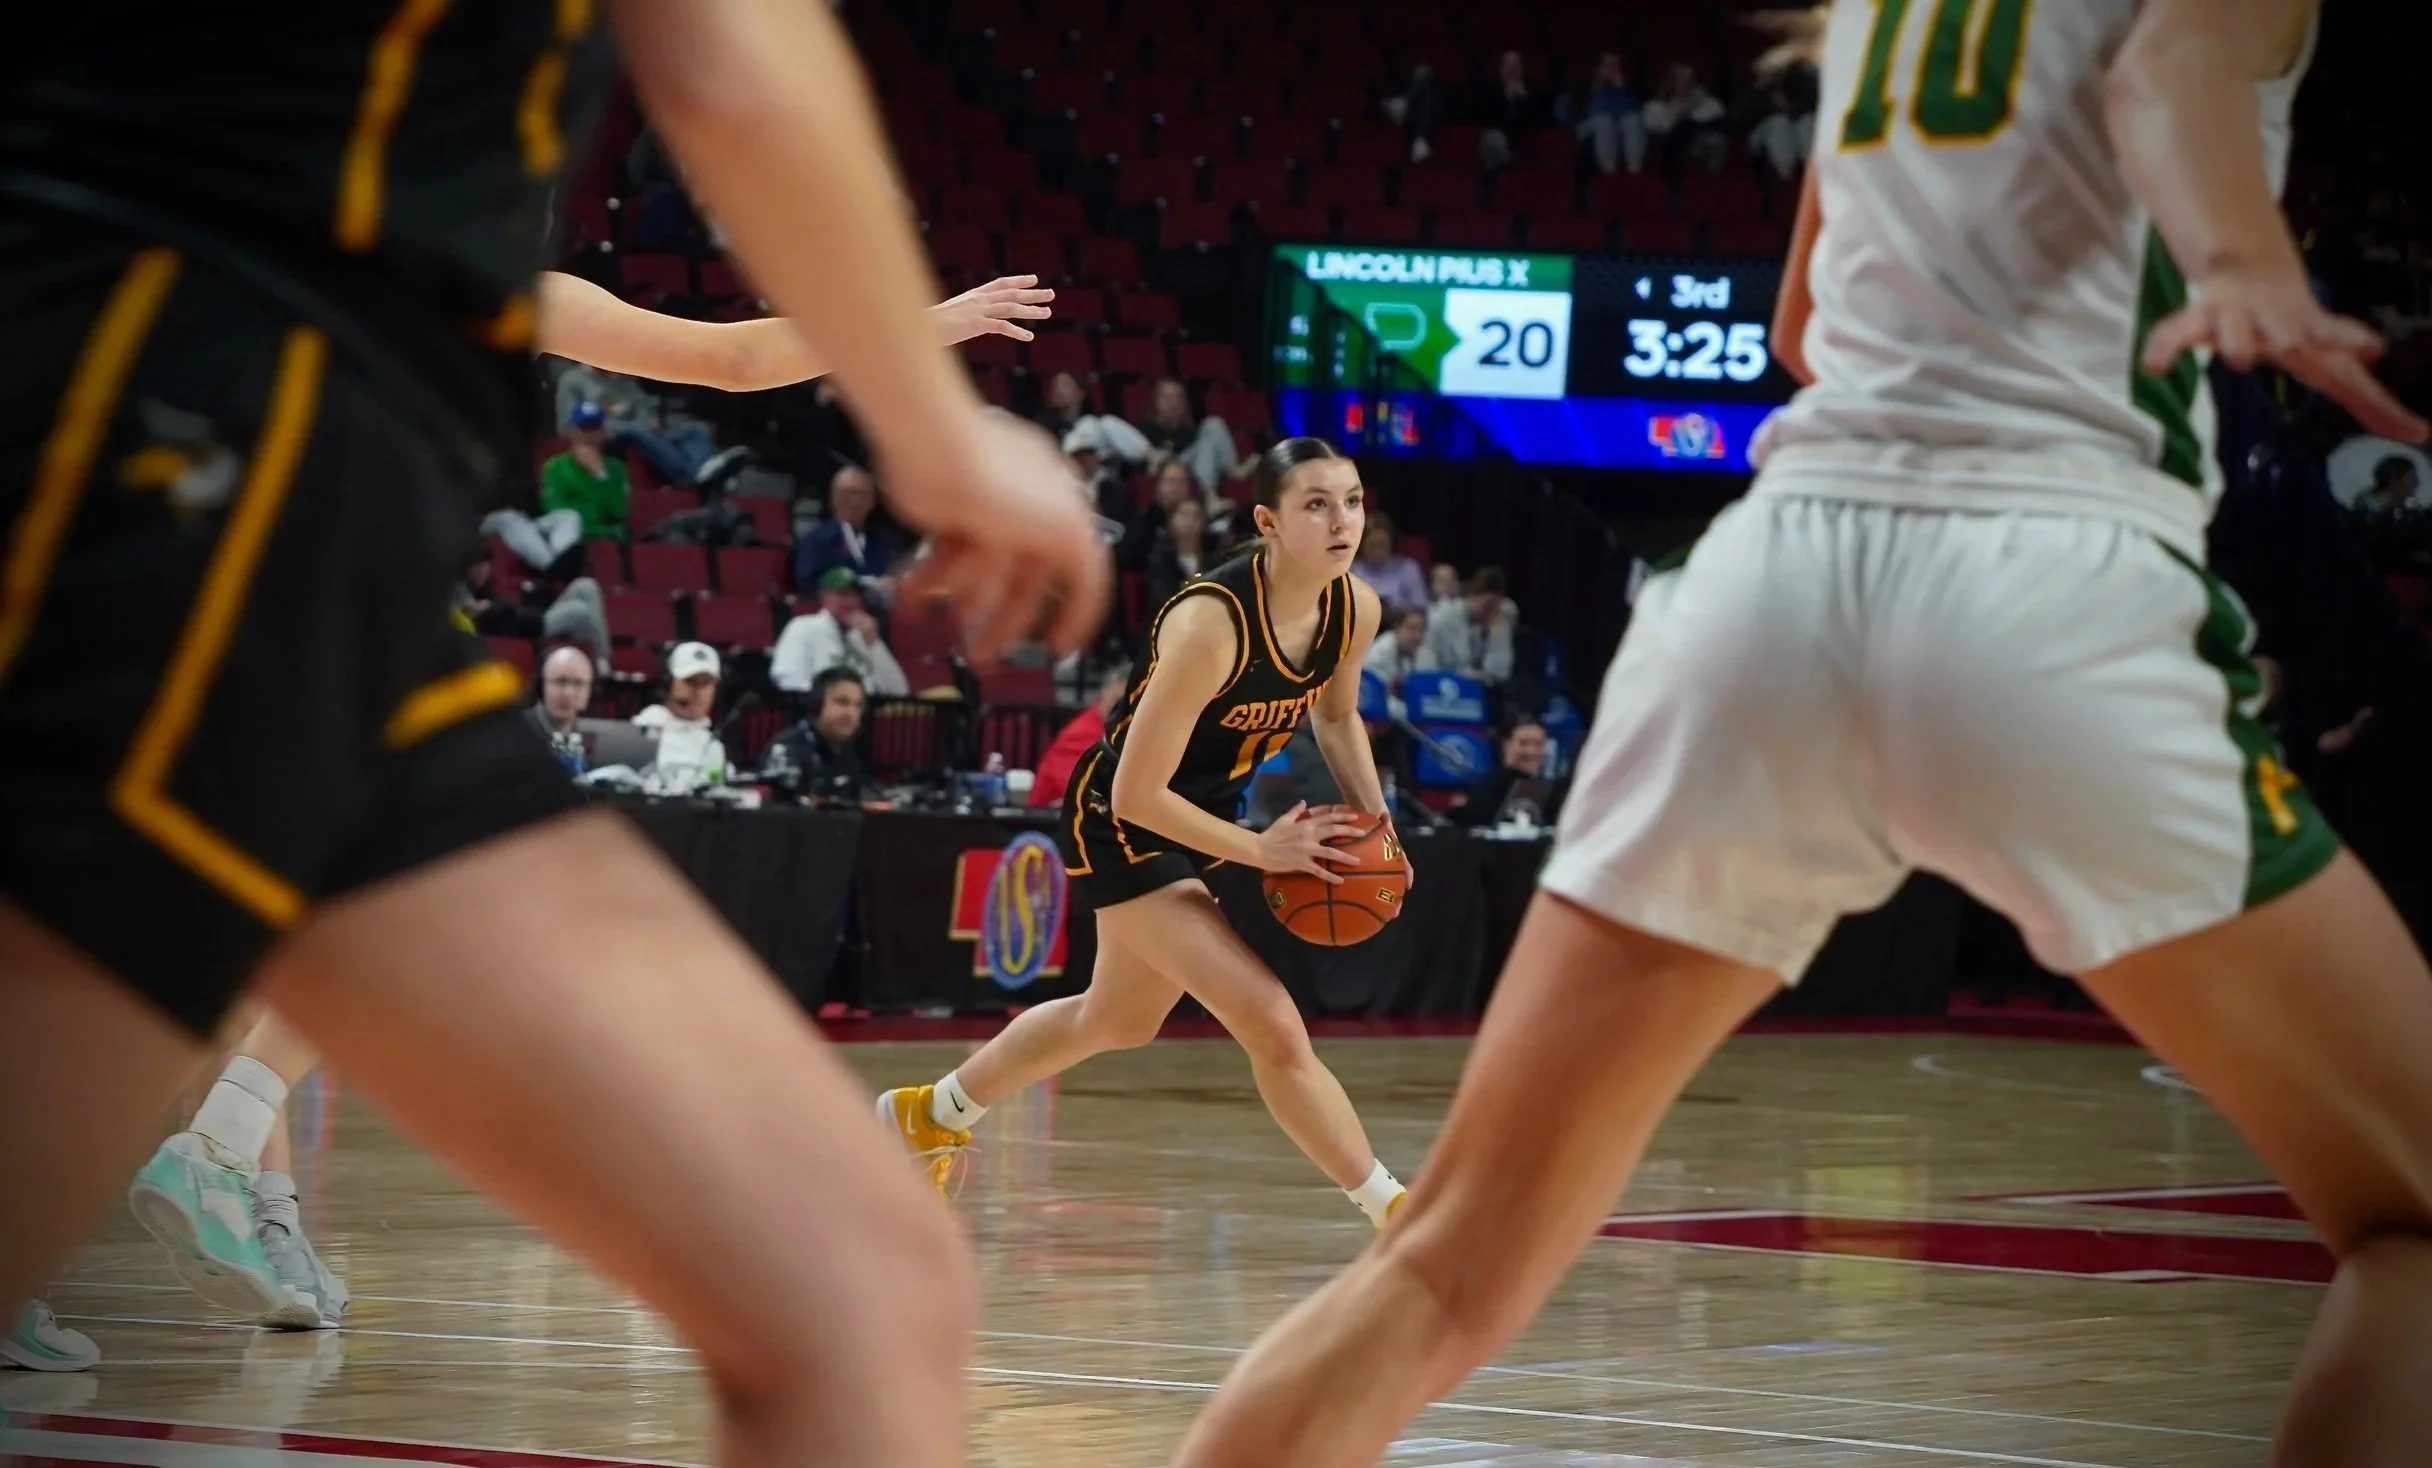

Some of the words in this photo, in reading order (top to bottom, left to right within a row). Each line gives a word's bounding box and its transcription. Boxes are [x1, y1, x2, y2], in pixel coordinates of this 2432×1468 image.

[1838, 0, 2032, 153] 10
[1306, 251, 1436, 284] LINCOLN
[1438, 256, 1504, 287] PIUS
[1507, 258, 1530, 287] X
[1671, 274, 1730, 310] 3rd
[1479, 320, 1552, 368] 20
[1623, 318, 1768, 382] 3:25
